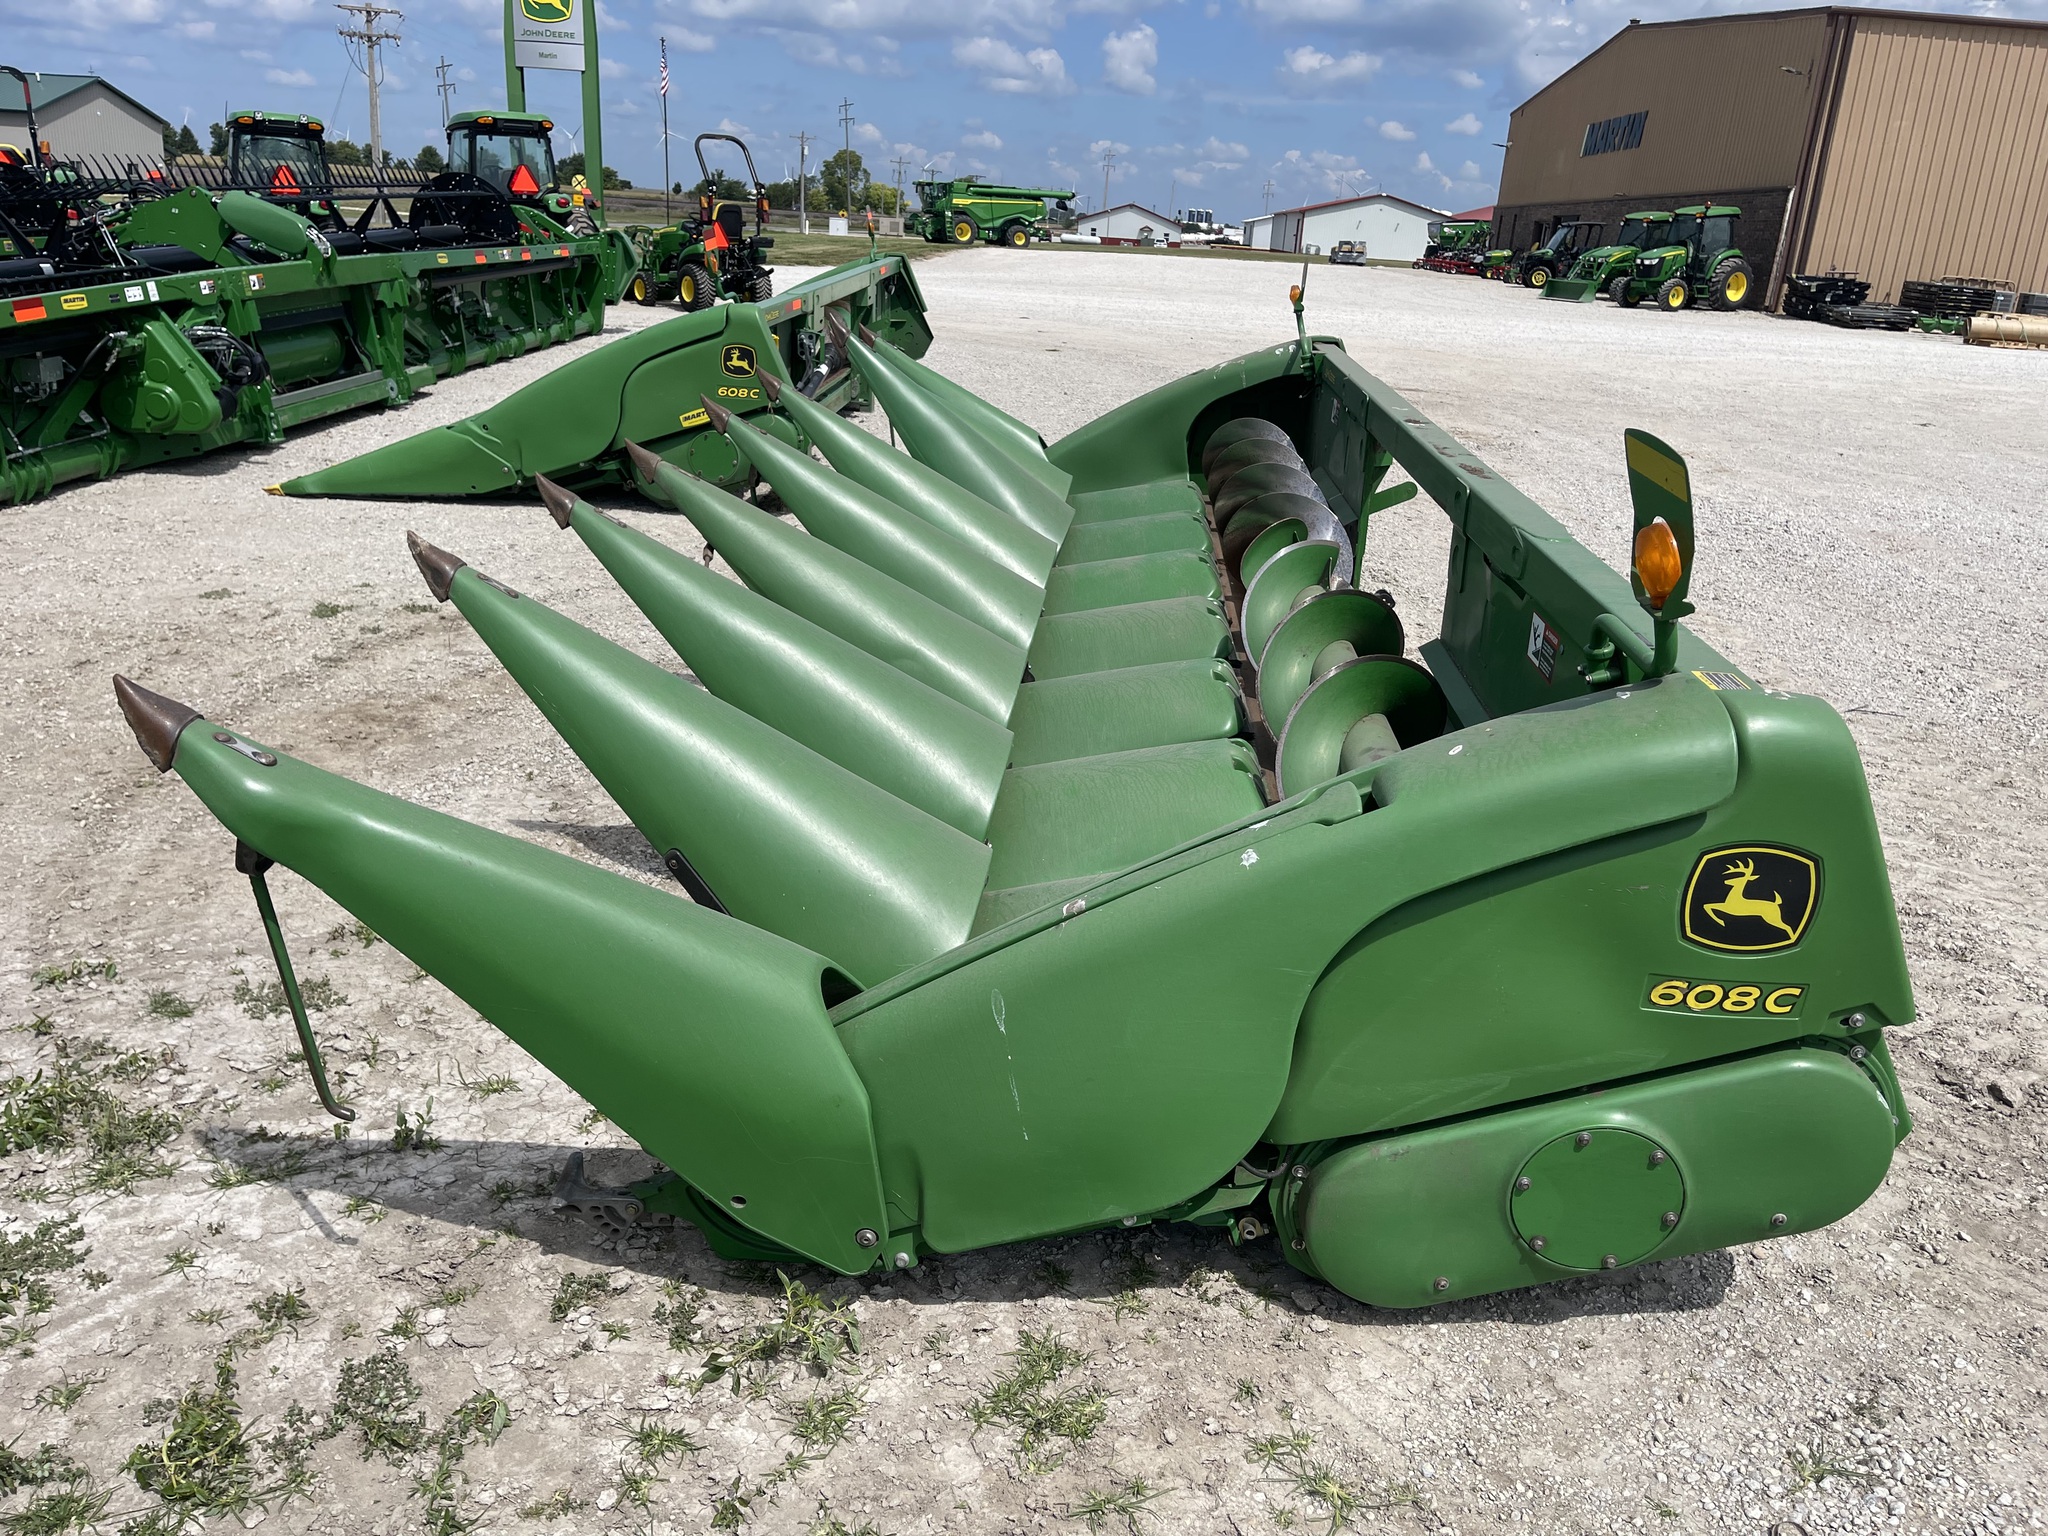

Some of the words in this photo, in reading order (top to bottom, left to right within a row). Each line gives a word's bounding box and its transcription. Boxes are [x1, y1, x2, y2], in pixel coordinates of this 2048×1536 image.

[521, 28, 543, 37] JOHN
[545, 29, 575, 39] DEERE
[1580, 110, 1649, 158] MARTIN
[683, 411, 707, 422] MART
